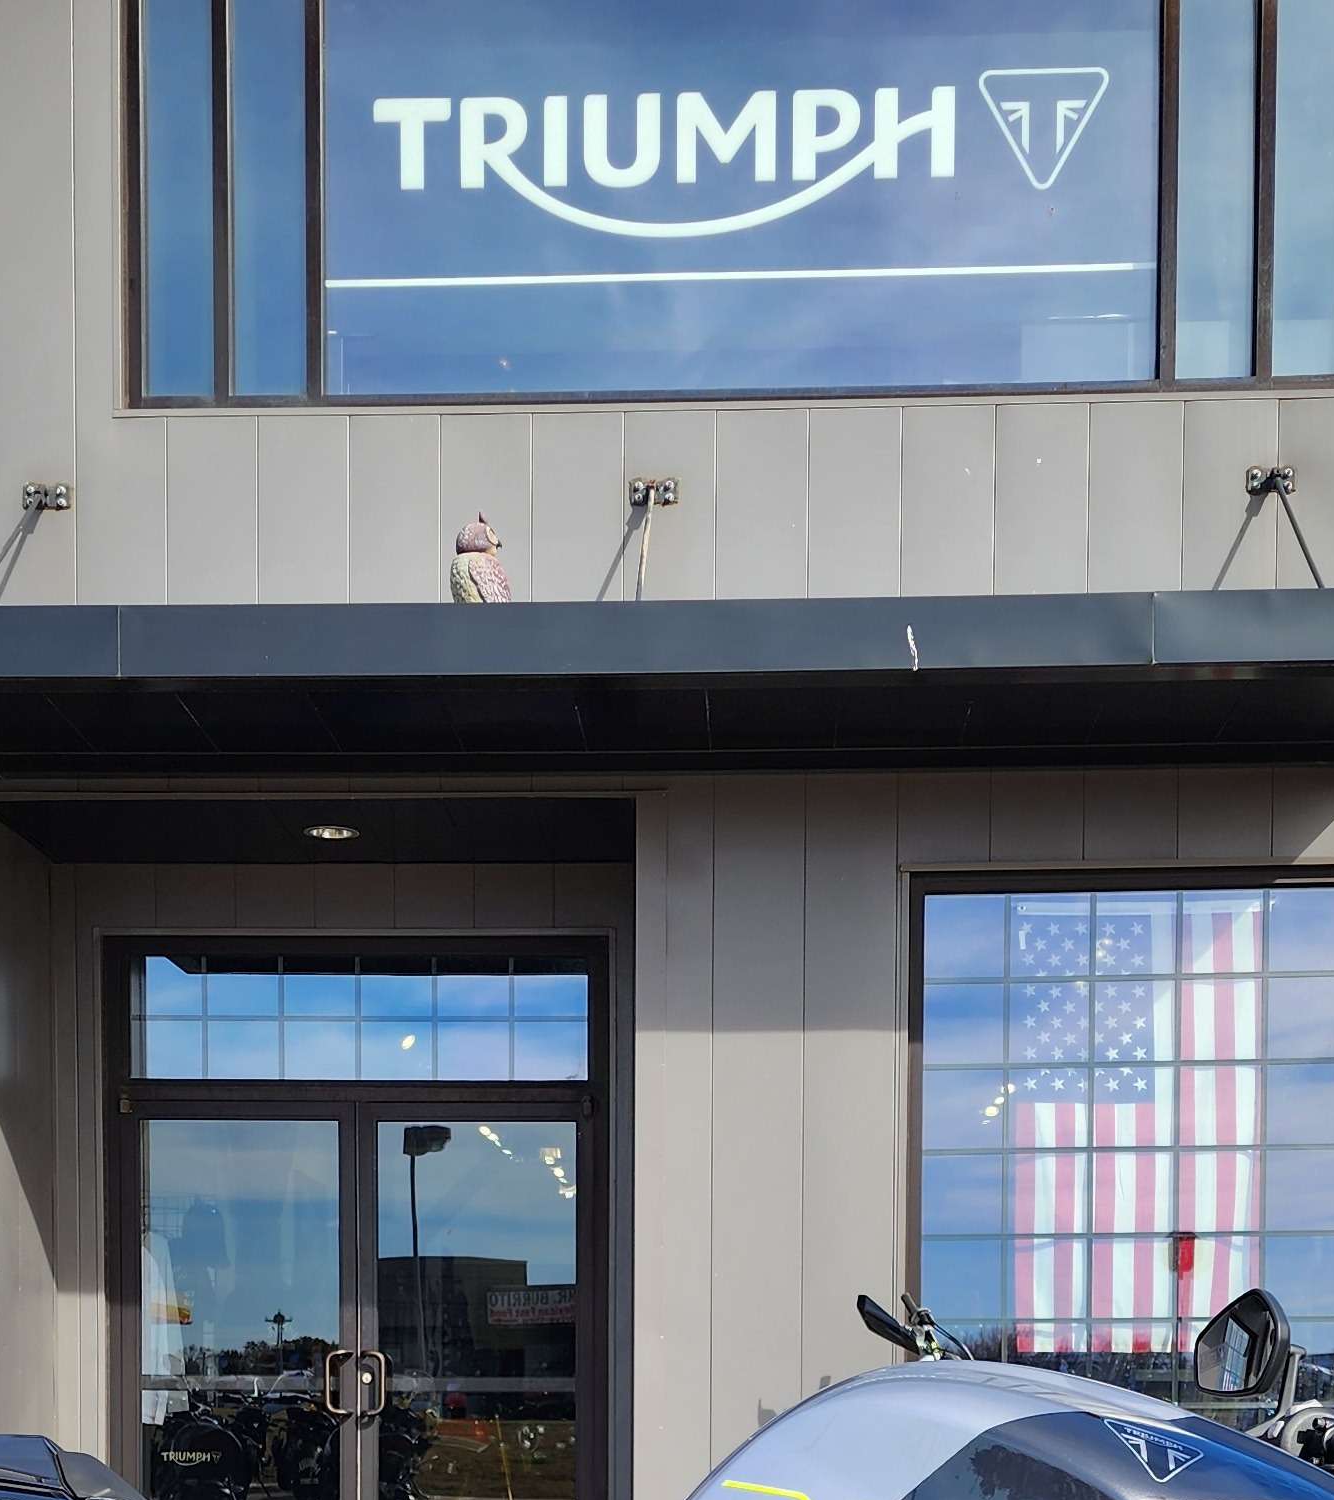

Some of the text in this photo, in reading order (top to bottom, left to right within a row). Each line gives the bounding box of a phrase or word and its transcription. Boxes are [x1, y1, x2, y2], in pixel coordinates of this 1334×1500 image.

[373, 86, 956, 237] TRIUMPH
[1124, 1427, 1184, 1451] TRIUMPH
[161, 1451, 211, 1467] TRIUMPH
